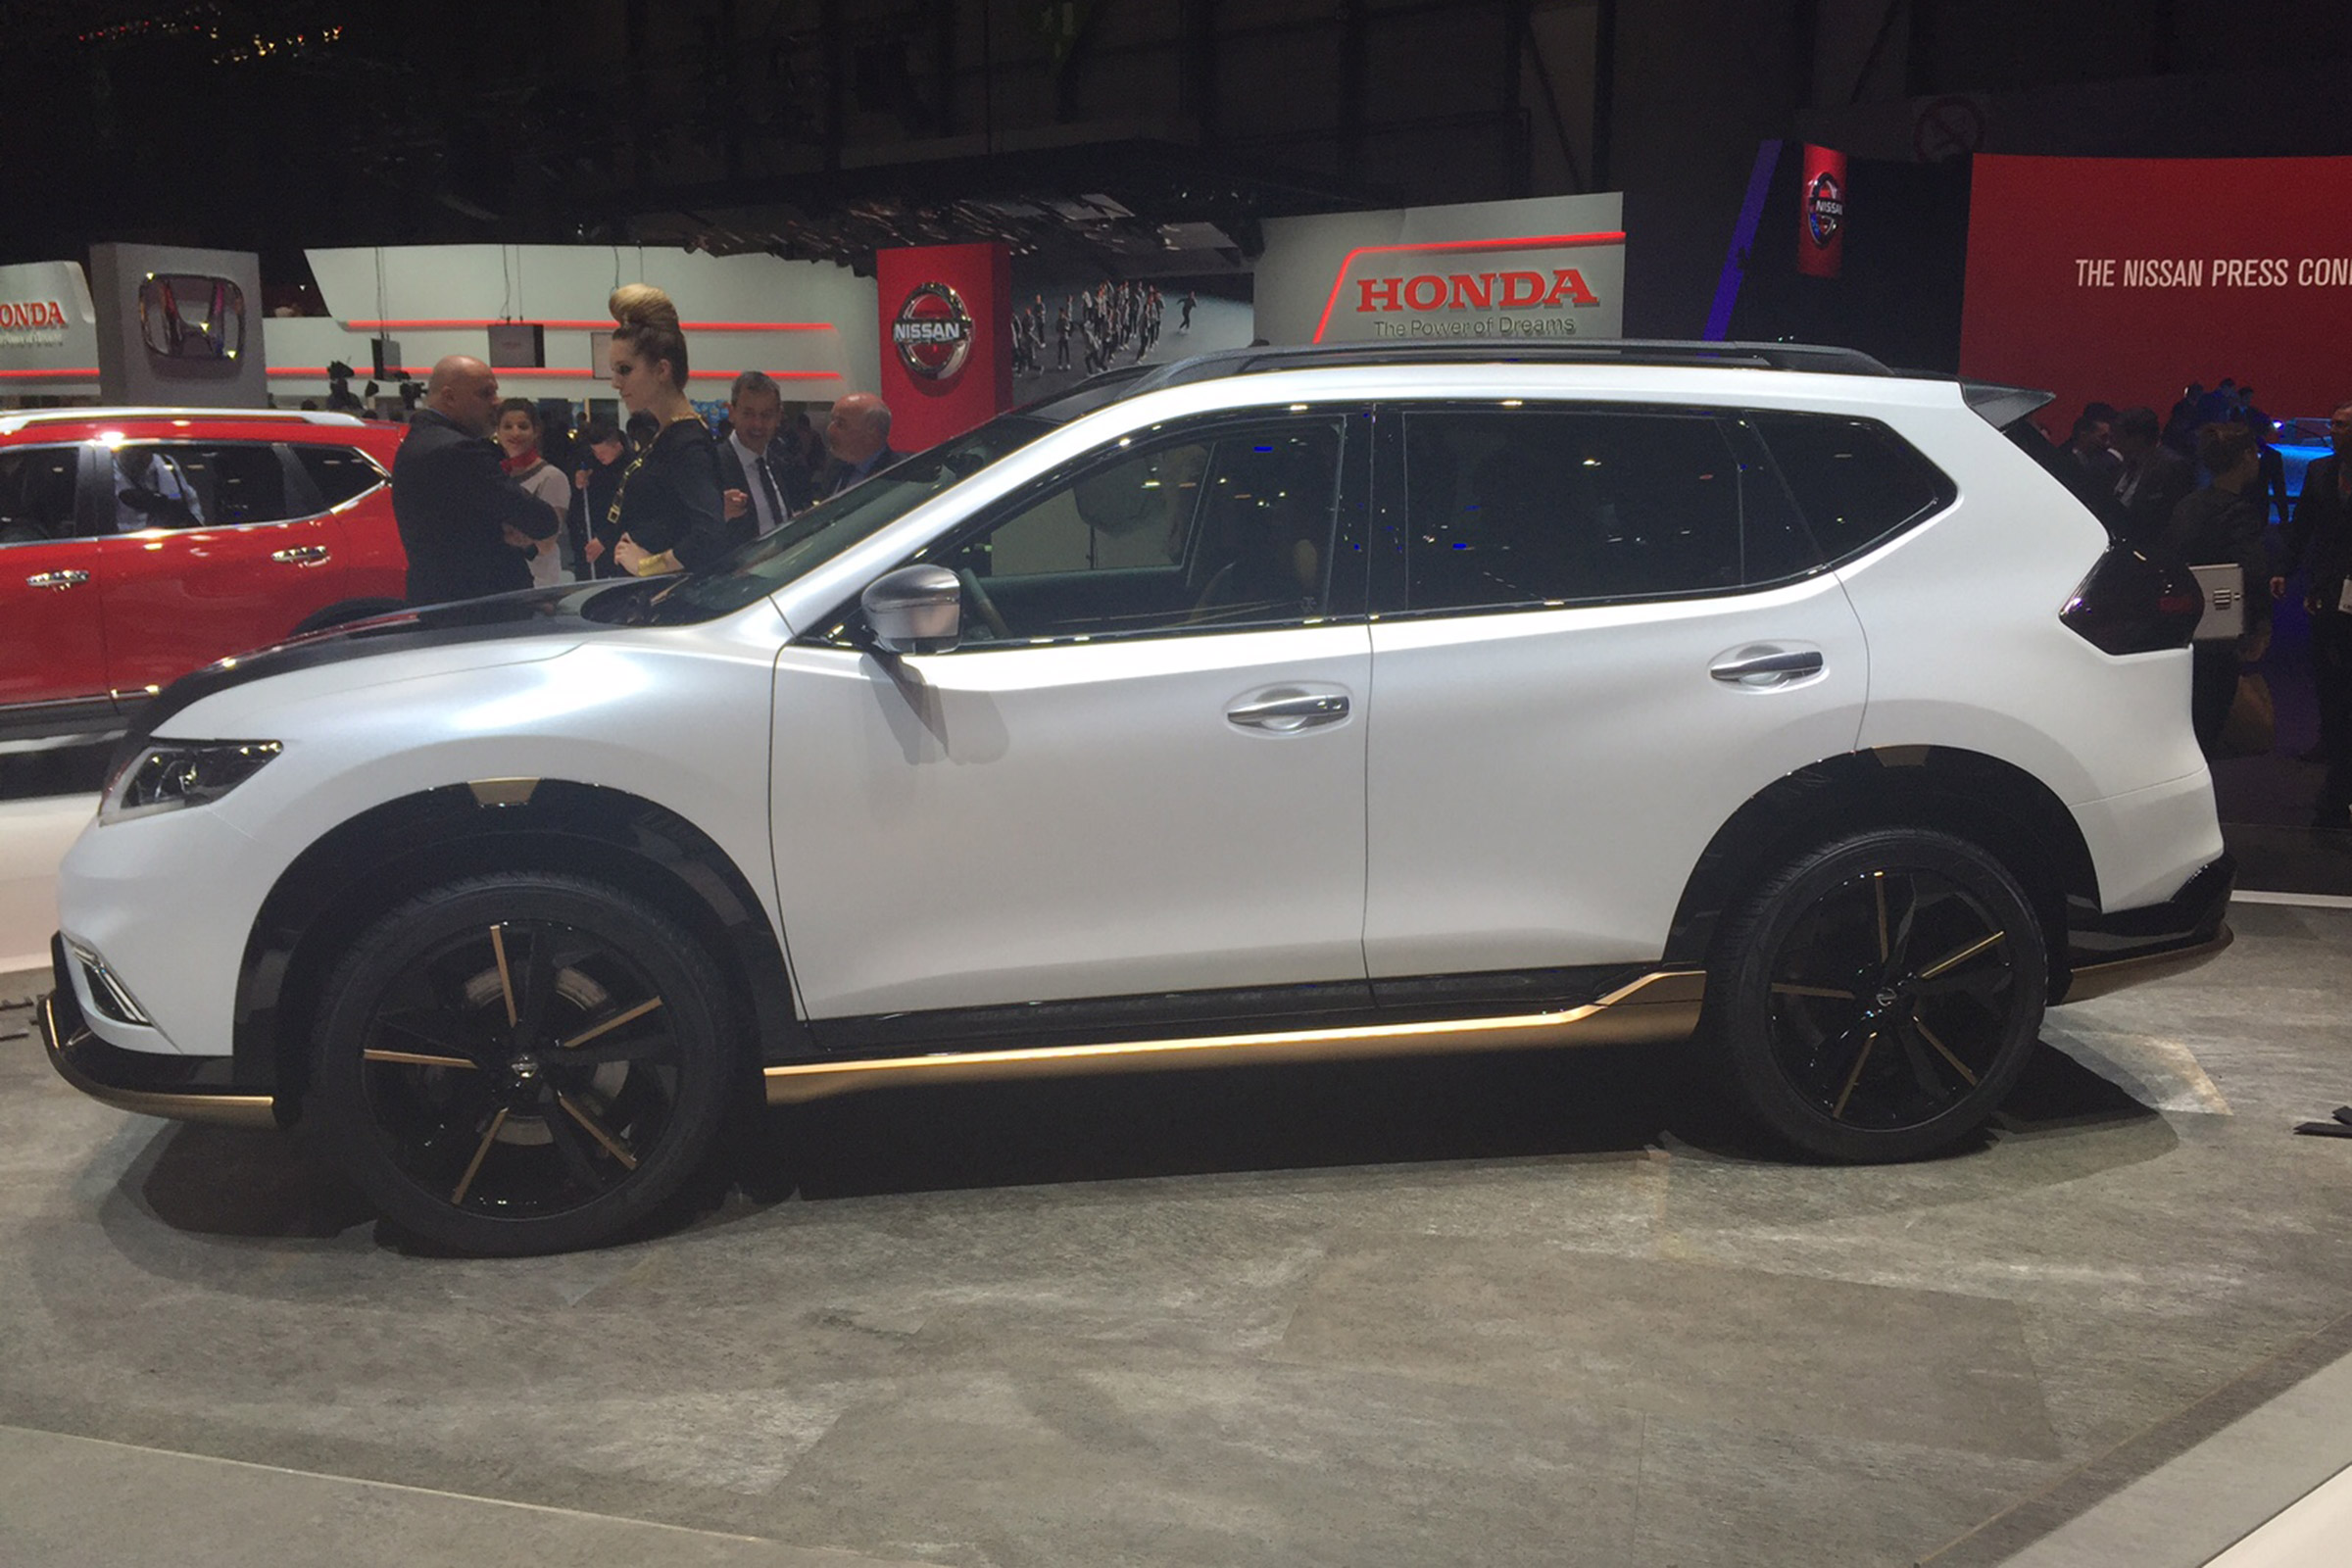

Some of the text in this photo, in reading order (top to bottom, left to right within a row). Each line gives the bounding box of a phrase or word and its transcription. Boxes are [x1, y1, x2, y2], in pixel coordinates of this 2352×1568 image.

[2076, 258, 2352, 287] THE NISSAN PRESS CON
[1356, 269, 1598, 312] HONDA
[894, 323, 959, 339] NISSAN
[1374, 317, 1576, 337] The Power of Dreams
